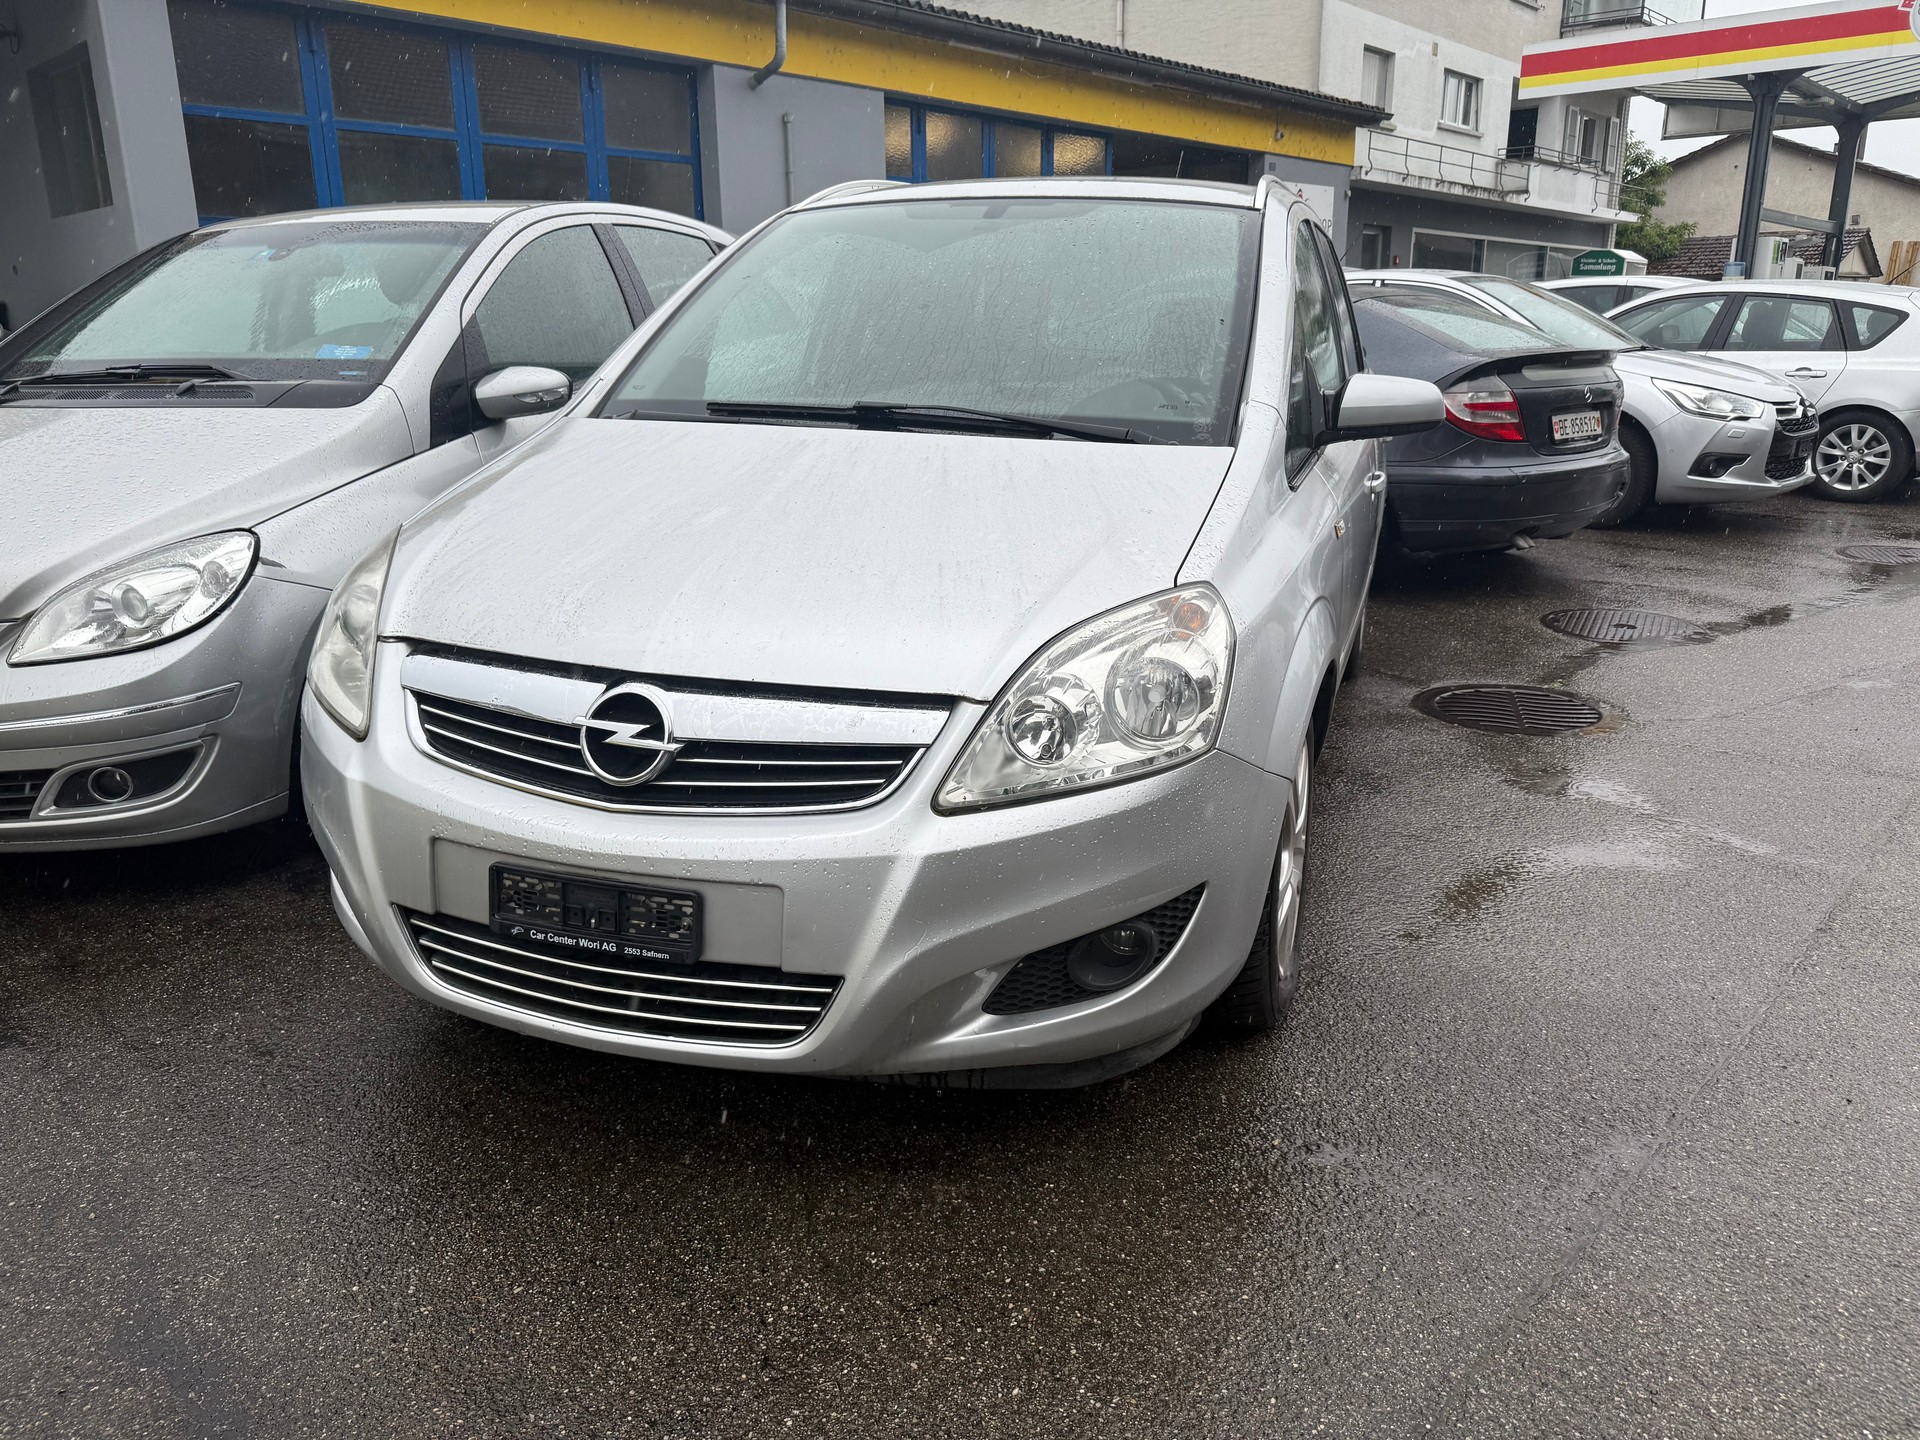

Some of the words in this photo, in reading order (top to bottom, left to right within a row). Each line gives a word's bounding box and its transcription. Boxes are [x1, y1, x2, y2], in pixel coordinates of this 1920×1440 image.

[1579, 263, 1616, 272] Sammlung
[530, 930, 545, 940] Car
[547, 933, 577, 945] Center
[578, 938, 600, 949] Wori
[602, 942, 617, 952] AG
[624, 947, 641, 956] 2553
[642, 950, 670, 960] Safnern
